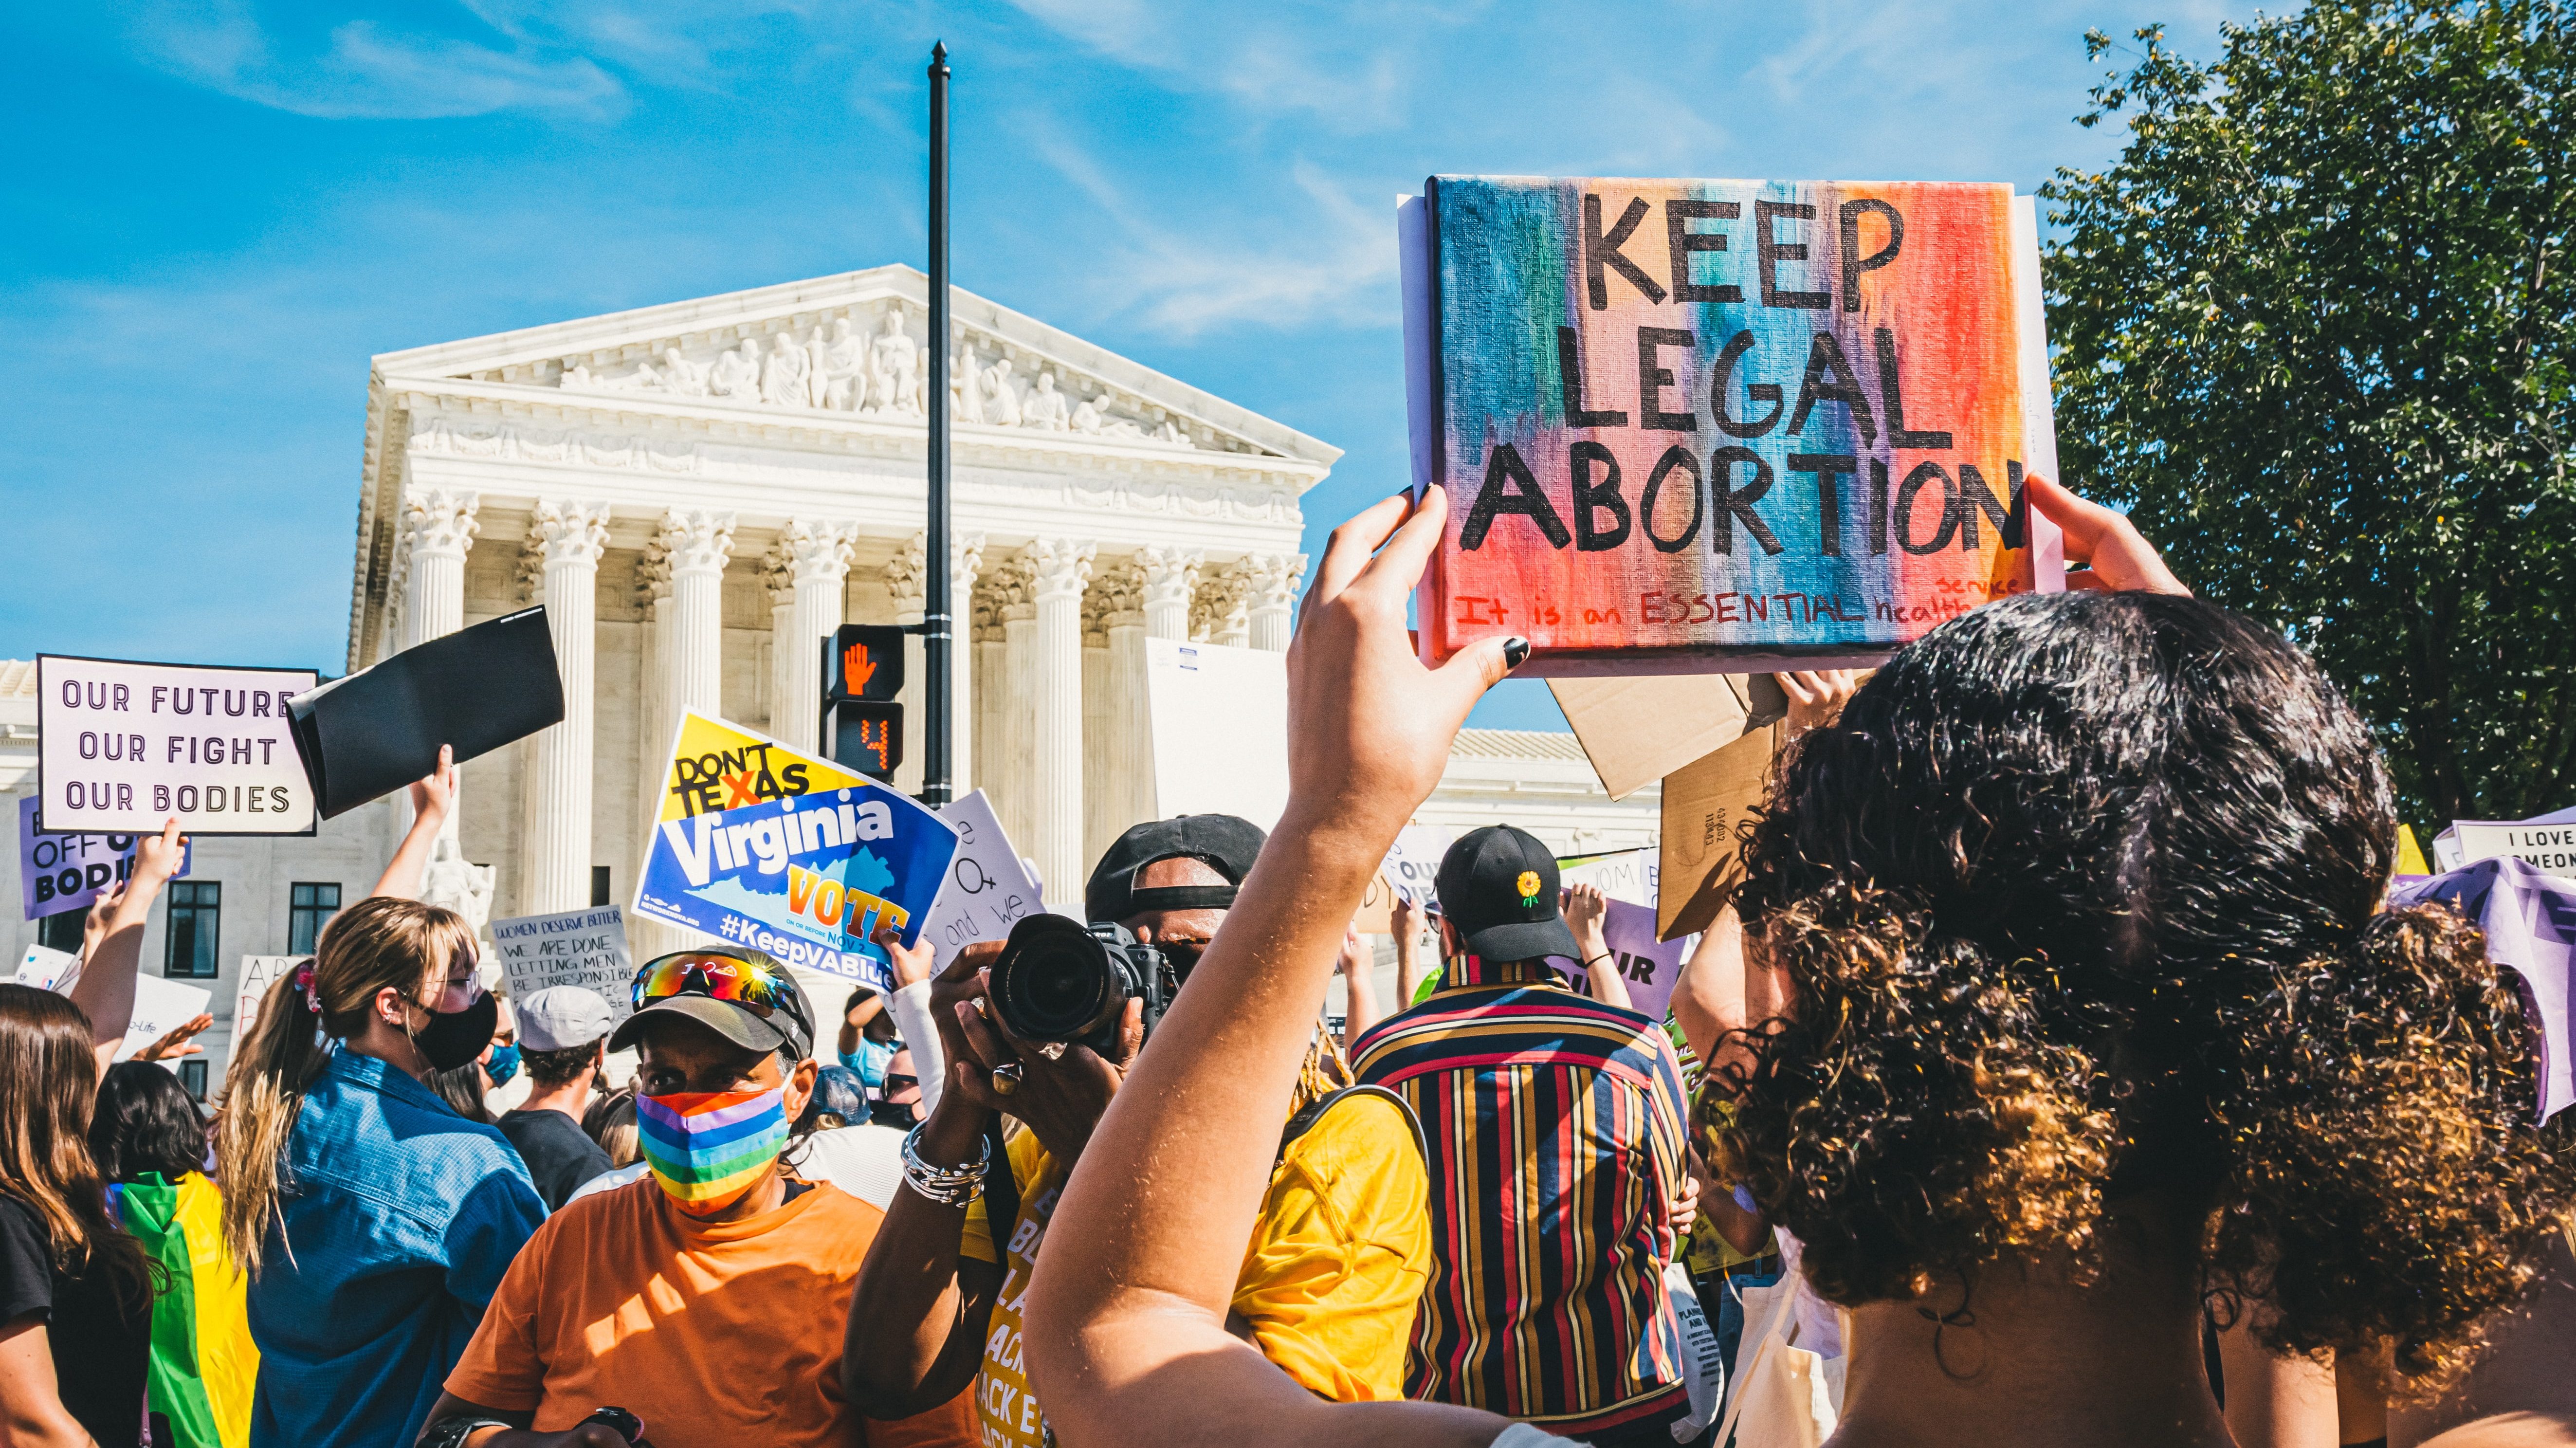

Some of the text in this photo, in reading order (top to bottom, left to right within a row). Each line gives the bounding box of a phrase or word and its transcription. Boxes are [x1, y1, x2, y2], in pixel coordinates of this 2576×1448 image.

[1584, 193, 1904, 312] KEEP
[1557, 327, 1953, 450] LEGAL
[1460, 441, 2030, 557] ABORTION
[1937, 575, 2019, 595] service
[1454, 596, 1509, 625] It
[1535, 595, 1561, 626] is
[1584, 607, 1622, 625] an
[1640, 591, 1865, 623] ESSENTIAL
[62, 679, 129, 712] OUR
[79, 731, 277, 765] OUR FIGHT
[861, 719, 887, 770] 4
[675, 742, 773, 783] DON'T
[66, 781, 290, 813] OUR BODIES
[671, 764, 810, 818] TEXAS
[659, 788, 895, 887] Virginia
[2509, 831, 2574, 846] I LOVE
[787, 863, 911, 946] VOTE
[946, 895, 1026, 946] and we
[494, 910, 622, 939] WOMEN DESERVE BETTER
[805, 926, 826, 937] BEFORE
[504, 935, 612, 957] WE ARE DONE
[827, 931, 866, 953] NOV 2
[509, 953, 616, 976] LETTING MEN
[1609, 948, 1656, 986] UR
[512, 979, 532, 992] BE
[129, 1020, 156, 1034] o-Life
